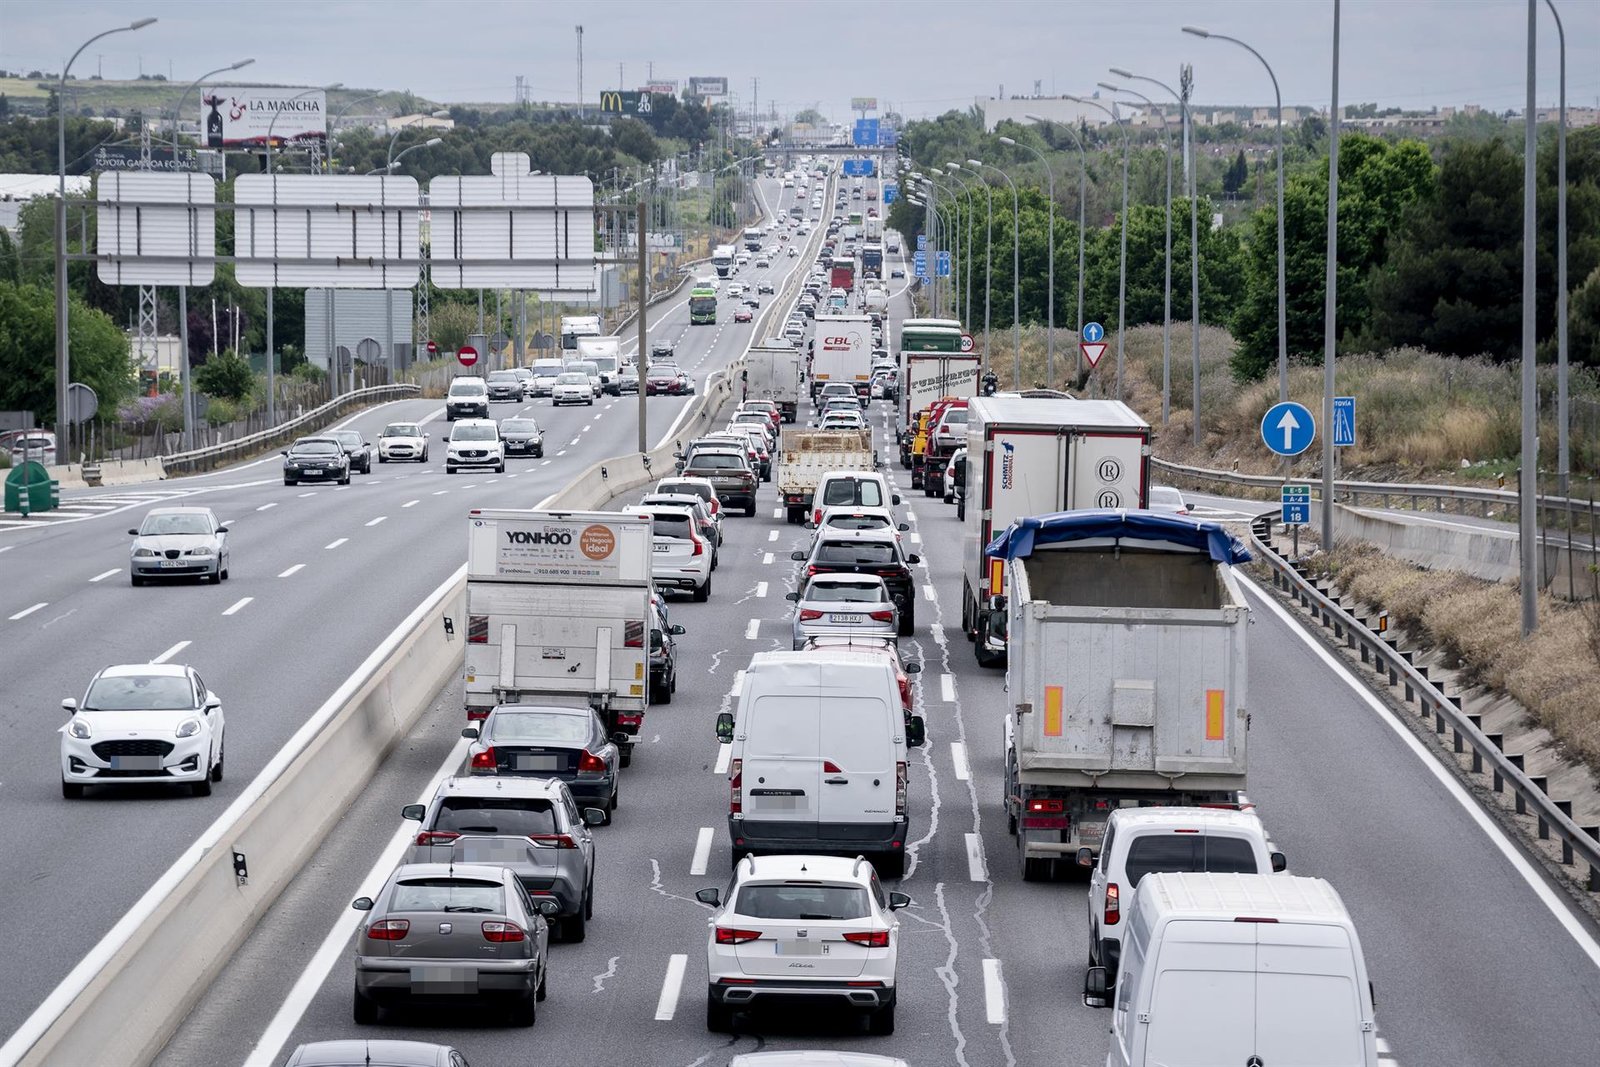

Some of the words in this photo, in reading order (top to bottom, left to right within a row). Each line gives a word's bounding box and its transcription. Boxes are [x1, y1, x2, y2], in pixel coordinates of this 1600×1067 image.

[250, 100, 264, 111] LA
[267, 100, 320, 111] MANCHA
[638, 102, 651, 112] 20
[95, 159, 126, 167] TOYOTA
[824, 336, 851, 345] CBL
[961, 339, 972, 348] 00
[1290, 513, 1302, 521] 18
[506, 531, 572, 545] YONHOO
[585, 543, 609, 552] Ideal
[823, 944, 830, 954] H
